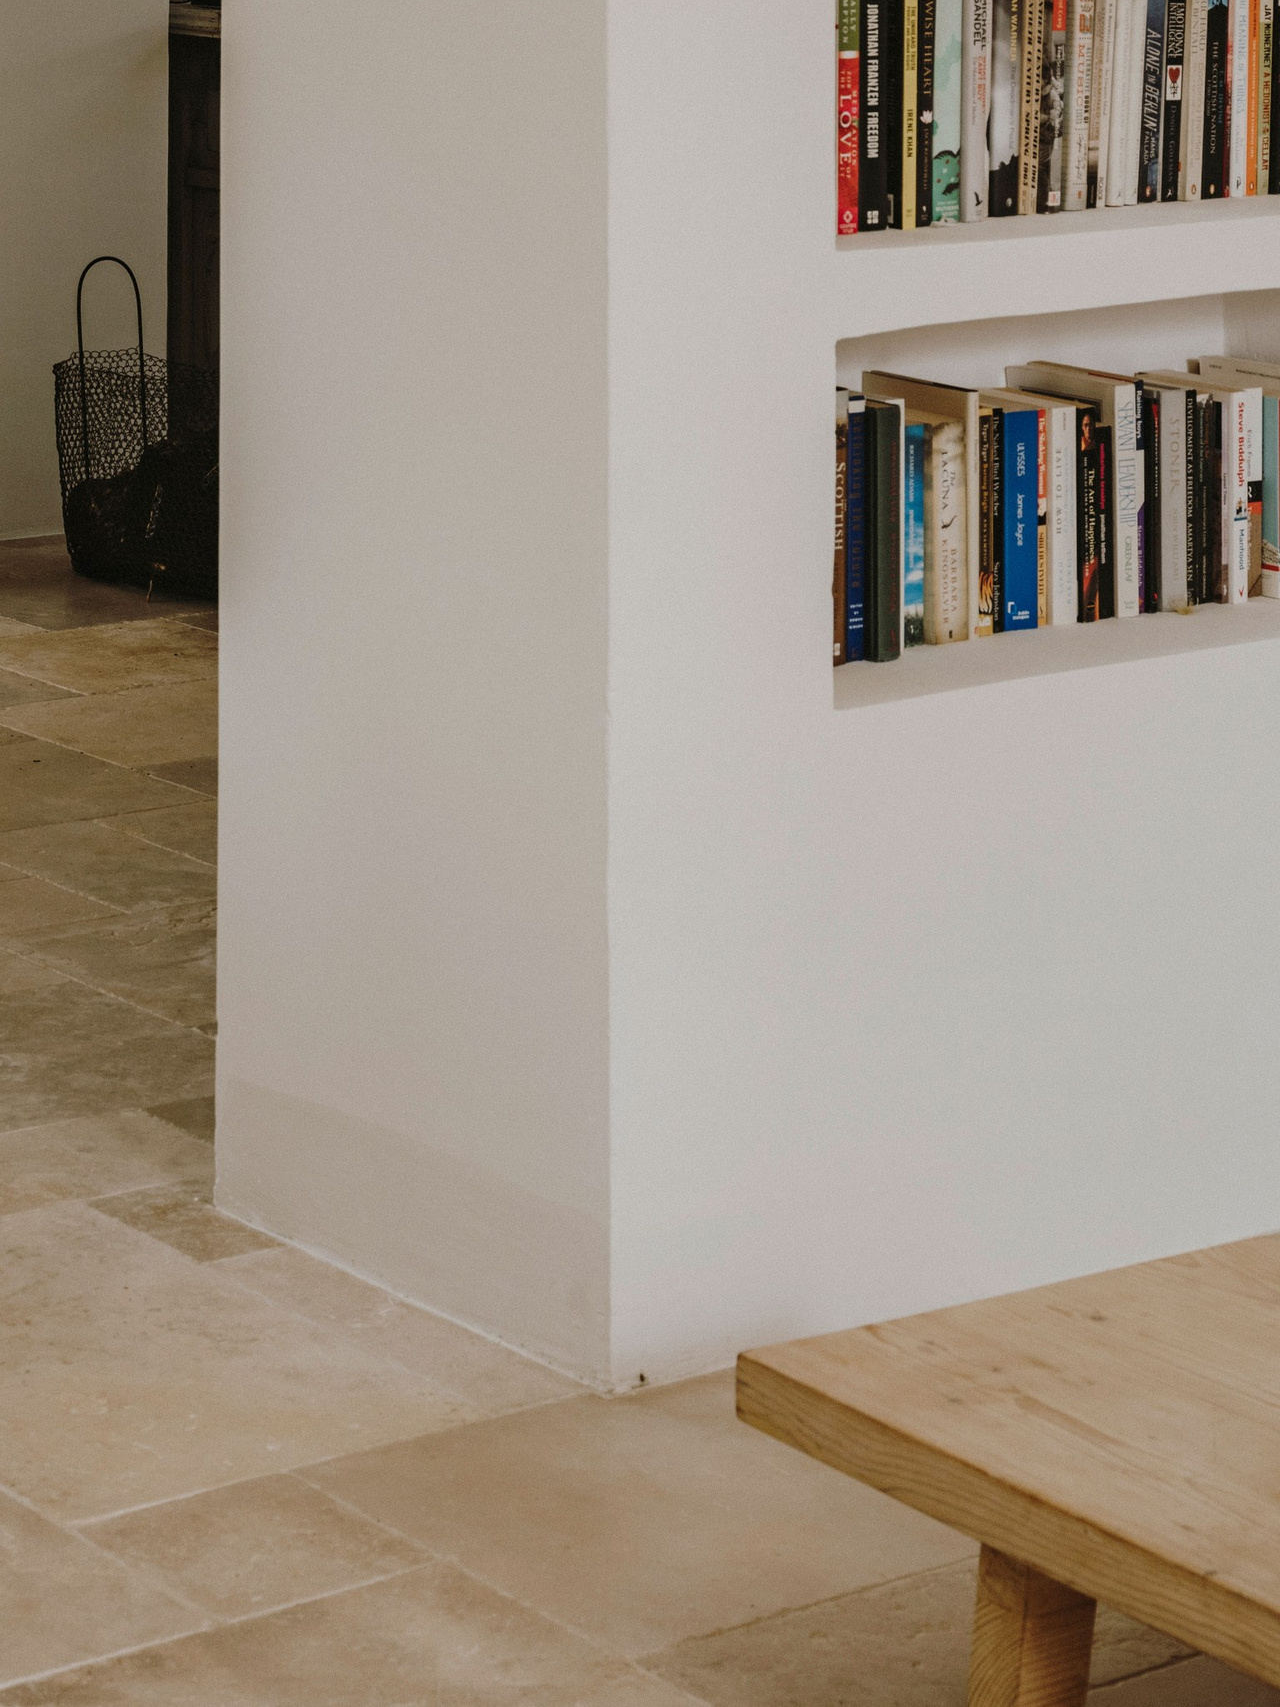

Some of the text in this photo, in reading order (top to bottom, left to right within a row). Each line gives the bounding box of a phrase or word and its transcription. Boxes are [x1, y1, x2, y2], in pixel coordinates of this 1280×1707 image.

[923, 1, 934, 97] WISE HEART
[1010, 14, 1018, 61] WARNER
[1168, 3, 1176, 58] INTELLIGENCE
[1175, 3, 1185, 58] EMOTIONAL
[867, 4, 879, 158] JONATHAN FRANZEN FREEDOM
[1077, 44, 1086, 107] MUSIC
[1143, 28, 1161, 131] ALONE IN BERLIN
[1262, 80, 1270, 125] HEDONIST
[840, 94, 852, 165] LOVE
[1261, 137, 1269, 170] CELLAR
[1118, 401, 1135, 452] SERVANT
[941, 452, 949, 510] LACUNA
[1017, 443, 1025, 476] ULYSSES
[1170, 417, 1181, 495] STONER
[1187, 464, 1193, 473] AS
[1237, 437, 1245, 487] Biddulph
[835, 462, 846, 550] SCOTTISH
[1015, 494, 1025, 546] James Joyce
[1119, 458, 1137, 527] LEADERSHIP
[1088, 518, 1096, 564] Happiness
[993, 584, 1001, 621] Johnston
